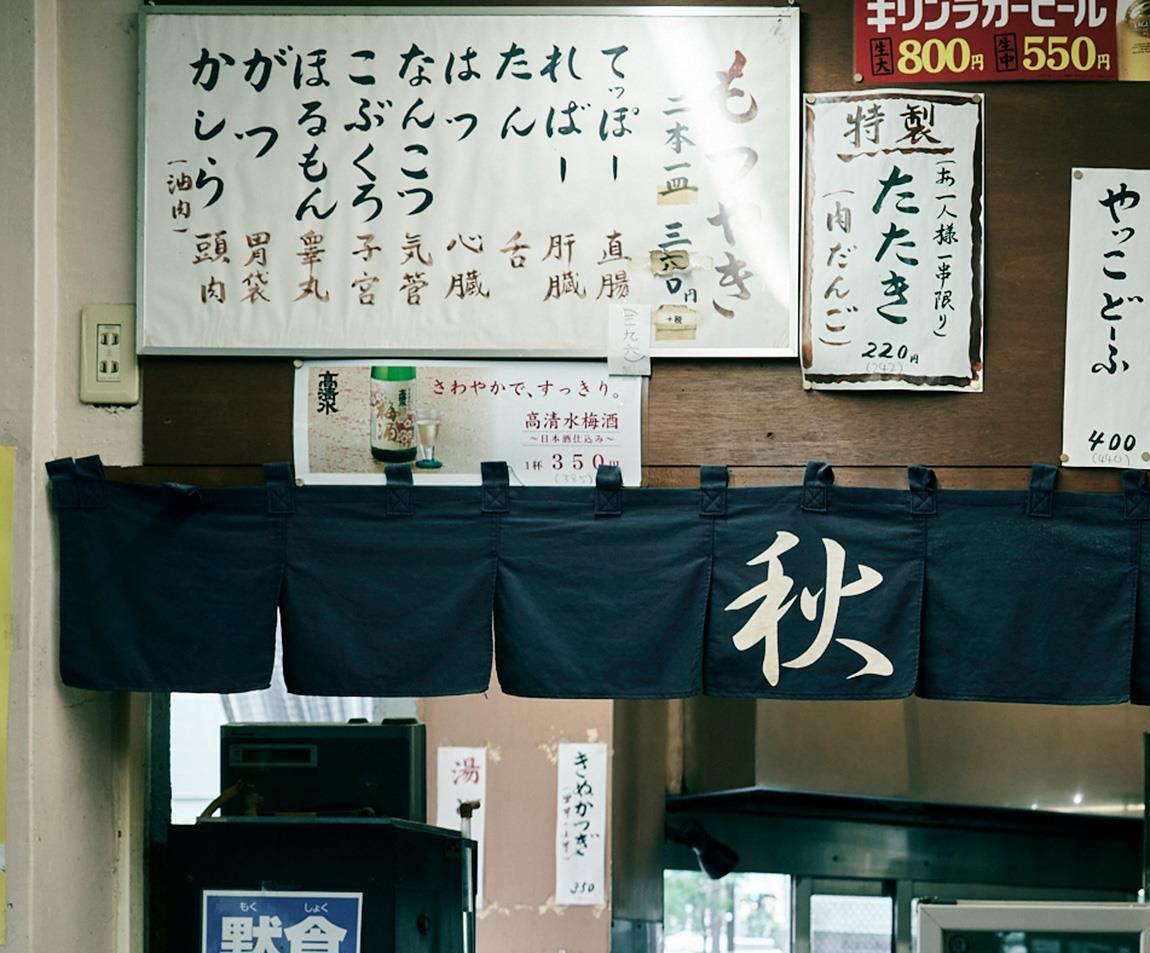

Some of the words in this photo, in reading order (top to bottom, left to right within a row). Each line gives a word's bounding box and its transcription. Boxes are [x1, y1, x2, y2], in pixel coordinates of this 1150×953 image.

[897, 37, 984, 74] 800円
[1022, 36, 1111, 71] 550円
[234, 45, 293, 158] がつ
[445, 46, 481, 141] はつ
[496, 42, 536, 139] たん
[189, 48, 235, 208] かしら
[293, 49, 338, 221] ほるもん
[344, 50, 393, 222] こぶくろ
[397, 43, 435, 215] なんこつ
[843, 104, 941, 149] 特製
[192, 230, 231, 304] 頭肉
[240, 231, 271, 303] 胃袋
[351, 233, 381, 305] 子宮
[400, 233, 433, 305] 気管
[444, 233, 490, 300] 心臓
[500, 230, 531, 269] 舌
[542, 234, 586, 302] 肝臓
[597, 230, 632, 300] 直腸
[872, 165, 920, 325] たたき
[861, 341, 919, 364] 220円
[432, 378, 620, 399] さわやかで、すっきり。
[525, 411, 619, 430] 高清水梅酒
[552, 453, 620, 471] 350
[1088, 430, 1136, 452] 400
[452, 756, 480, 785] 湯
